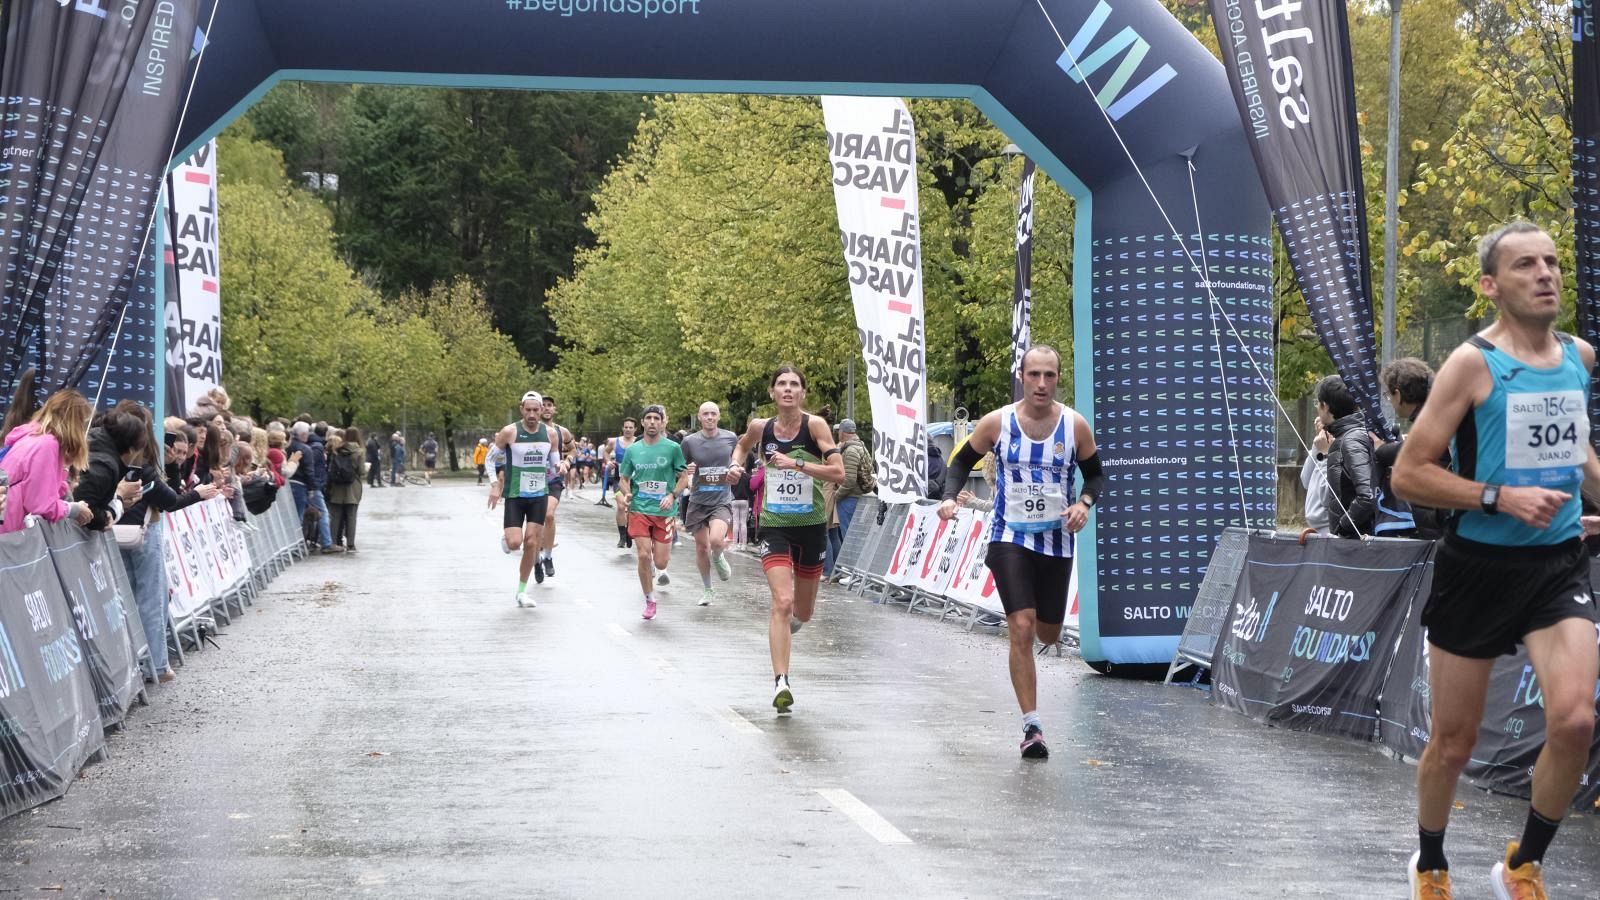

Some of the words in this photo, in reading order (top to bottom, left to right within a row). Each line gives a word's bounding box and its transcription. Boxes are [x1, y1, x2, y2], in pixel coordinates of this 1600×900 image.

[142, 1, 175, 97] INSPIRED
[1512, 404, 1543, 414] SALTO
[1528, 422, 1577, 448] 304
[1101, 456, 1188, 468] saltofoundation.org
[1537, 451, 1571, 461] JUANJO
[528, 480, 537, 488] 31
[646, 481, 660, 489] 135
[777, 483, 803, 495] 401
[1024, 498, 1046, 513] 96
[1304, 584, 1354, 621] SALTO
[1123, 606, 1171, 620] SALTO
